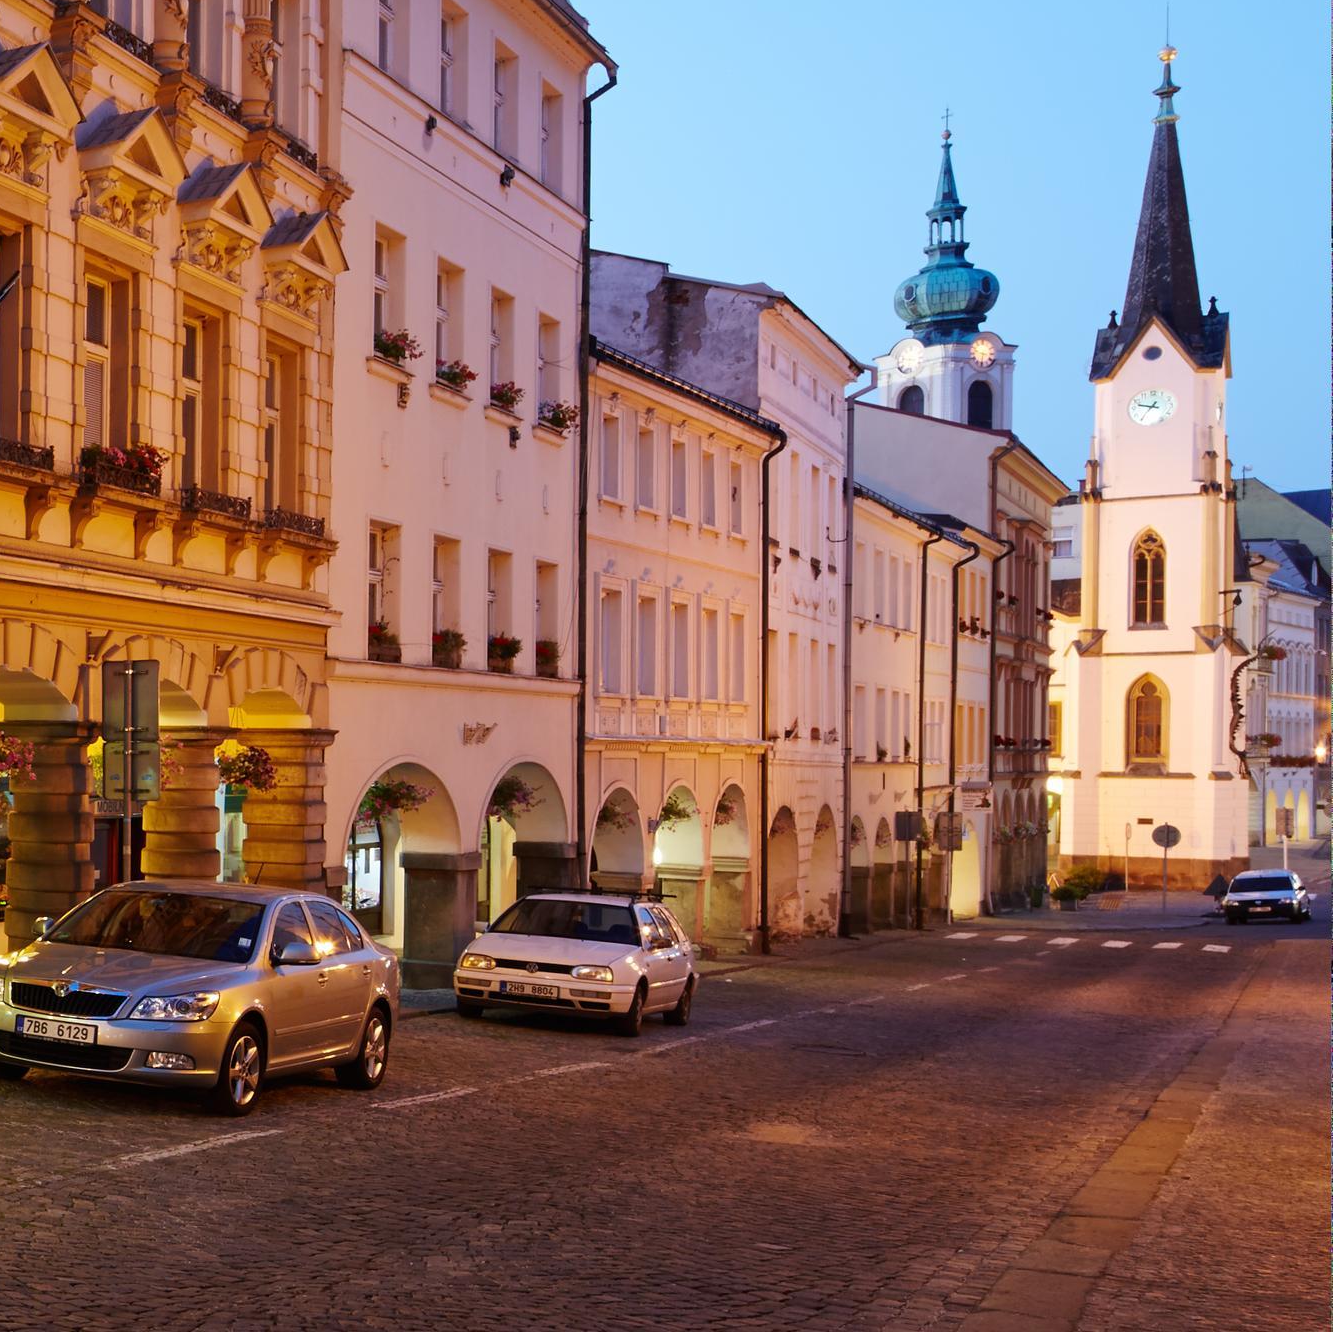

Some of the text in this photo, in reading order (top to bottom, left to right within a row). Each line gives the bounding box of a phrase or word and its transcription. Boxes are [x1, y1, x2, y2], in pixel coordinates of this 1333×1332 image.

[508, 983, 554, 996] 2H9 8804
[26, 1019, 49, 1035] 7B6
[57, 1024, 89, 1041] 6129
